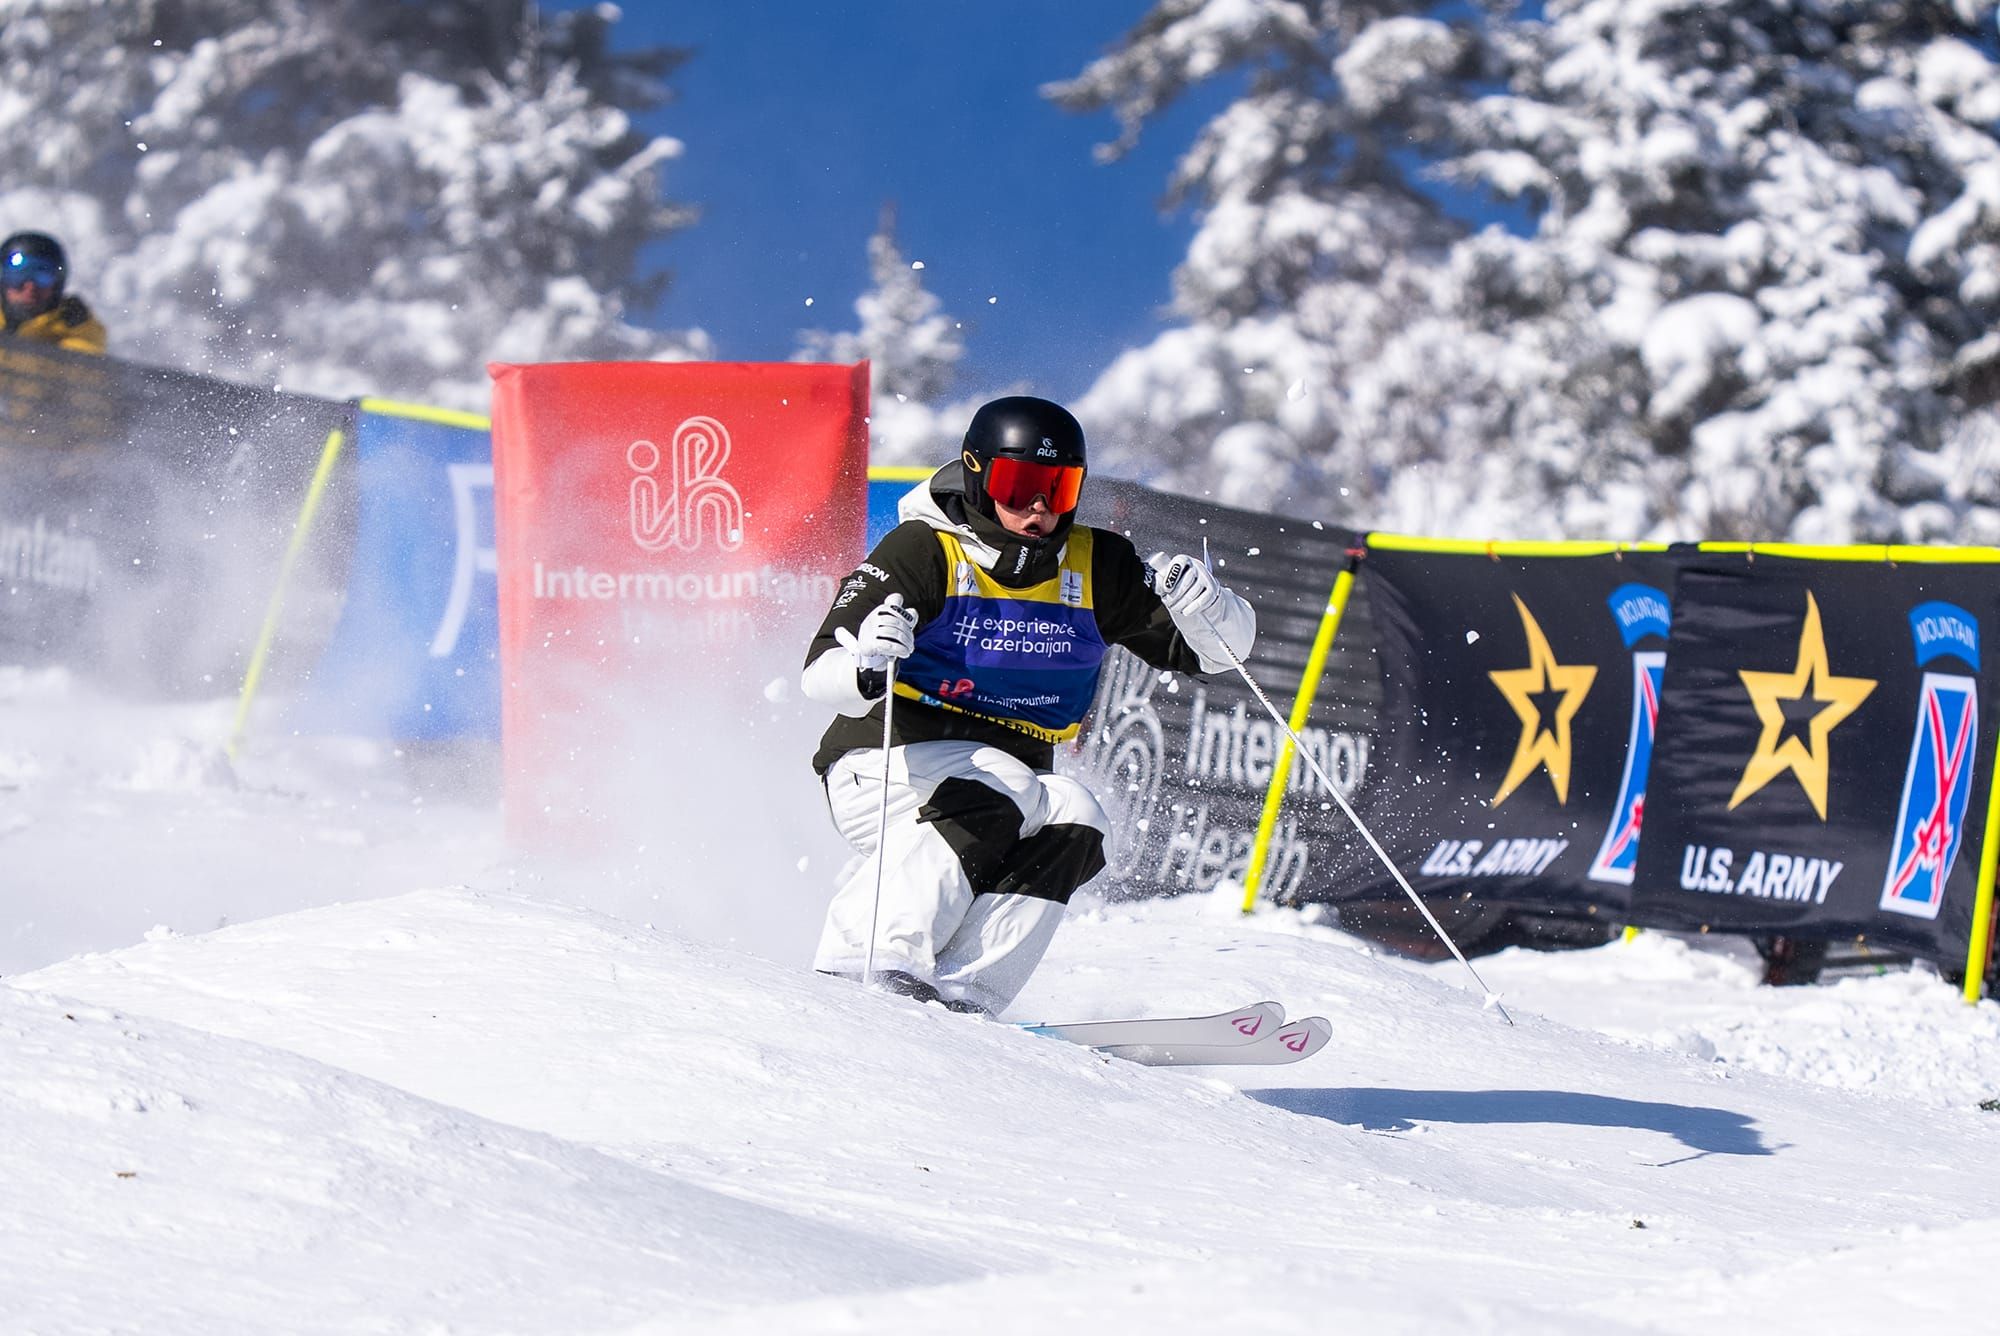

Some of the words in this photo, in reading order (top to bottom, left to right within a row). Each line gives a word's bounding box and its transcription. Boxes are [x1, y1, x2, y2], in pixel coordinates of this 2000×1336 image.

[1036, 447, 1058, 458] AUS
[534, 562, 835, 600] Intermountain
[981, 636, 1071, 658] azerbaijan
[1916, 615, 1976, 652] MOUNTAIN
[1157, 802, 1309, 900] Heath
[1470, 837, 1570, 877] ARMY
[1680, 843, 1735, 894] U.S.
[1735, 850, 1844, 905] ARMY
